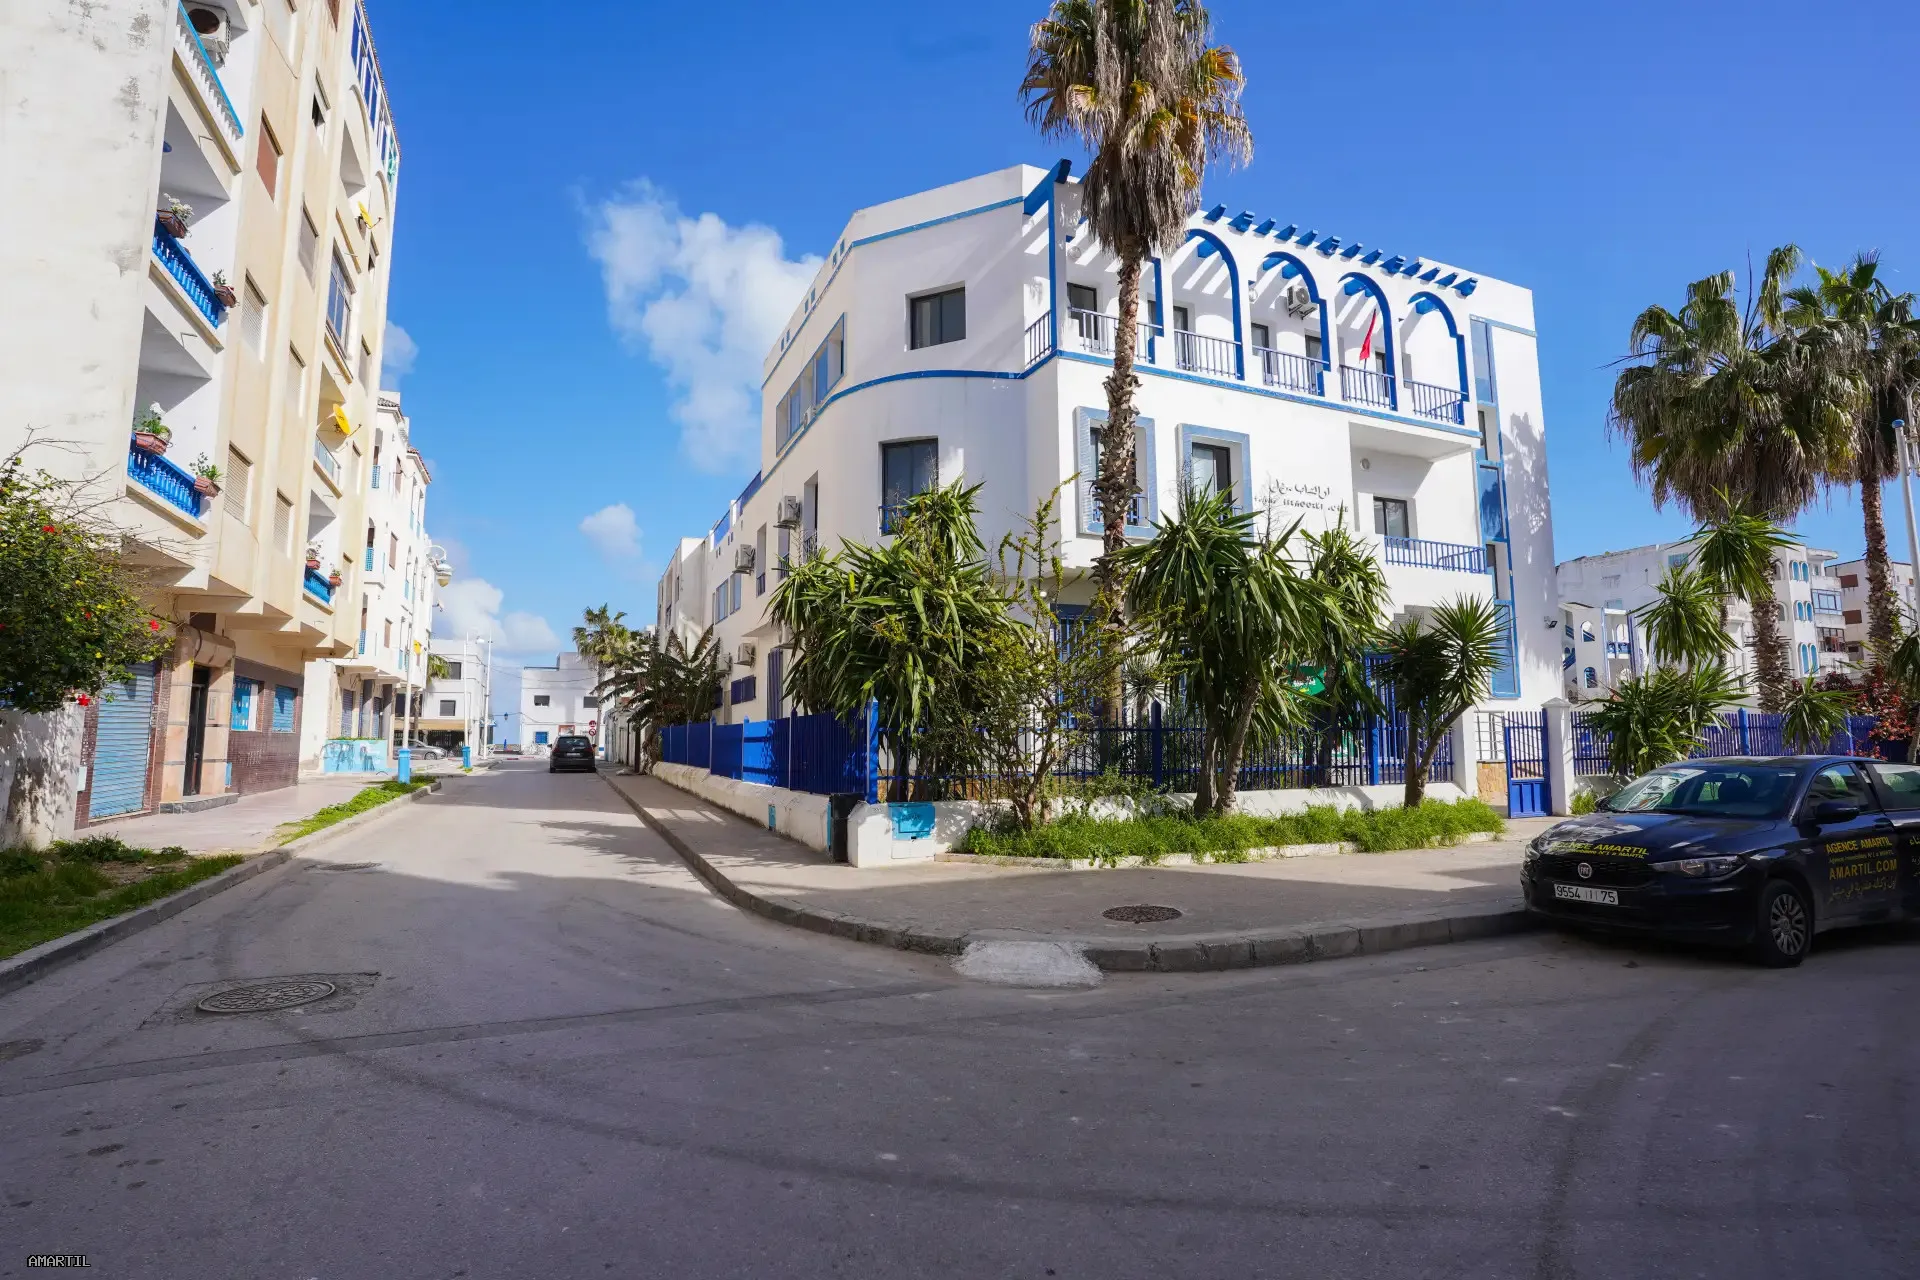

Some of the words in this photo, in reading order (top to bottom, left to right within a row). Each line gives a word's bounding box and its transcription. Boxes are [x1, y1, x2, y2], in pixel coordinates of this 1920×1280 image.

[1594, 844, 1650, 855] AMARTIL
[1826, 840, 1858, 854] AGENCE
[1860, 836, 1893, 849] AMARTIL
[1829, 858, 1898, 880] AMARTIL.COM
[1556, 886, 1581, 899] 9554
[1601, 891, 1616, 903] 75
